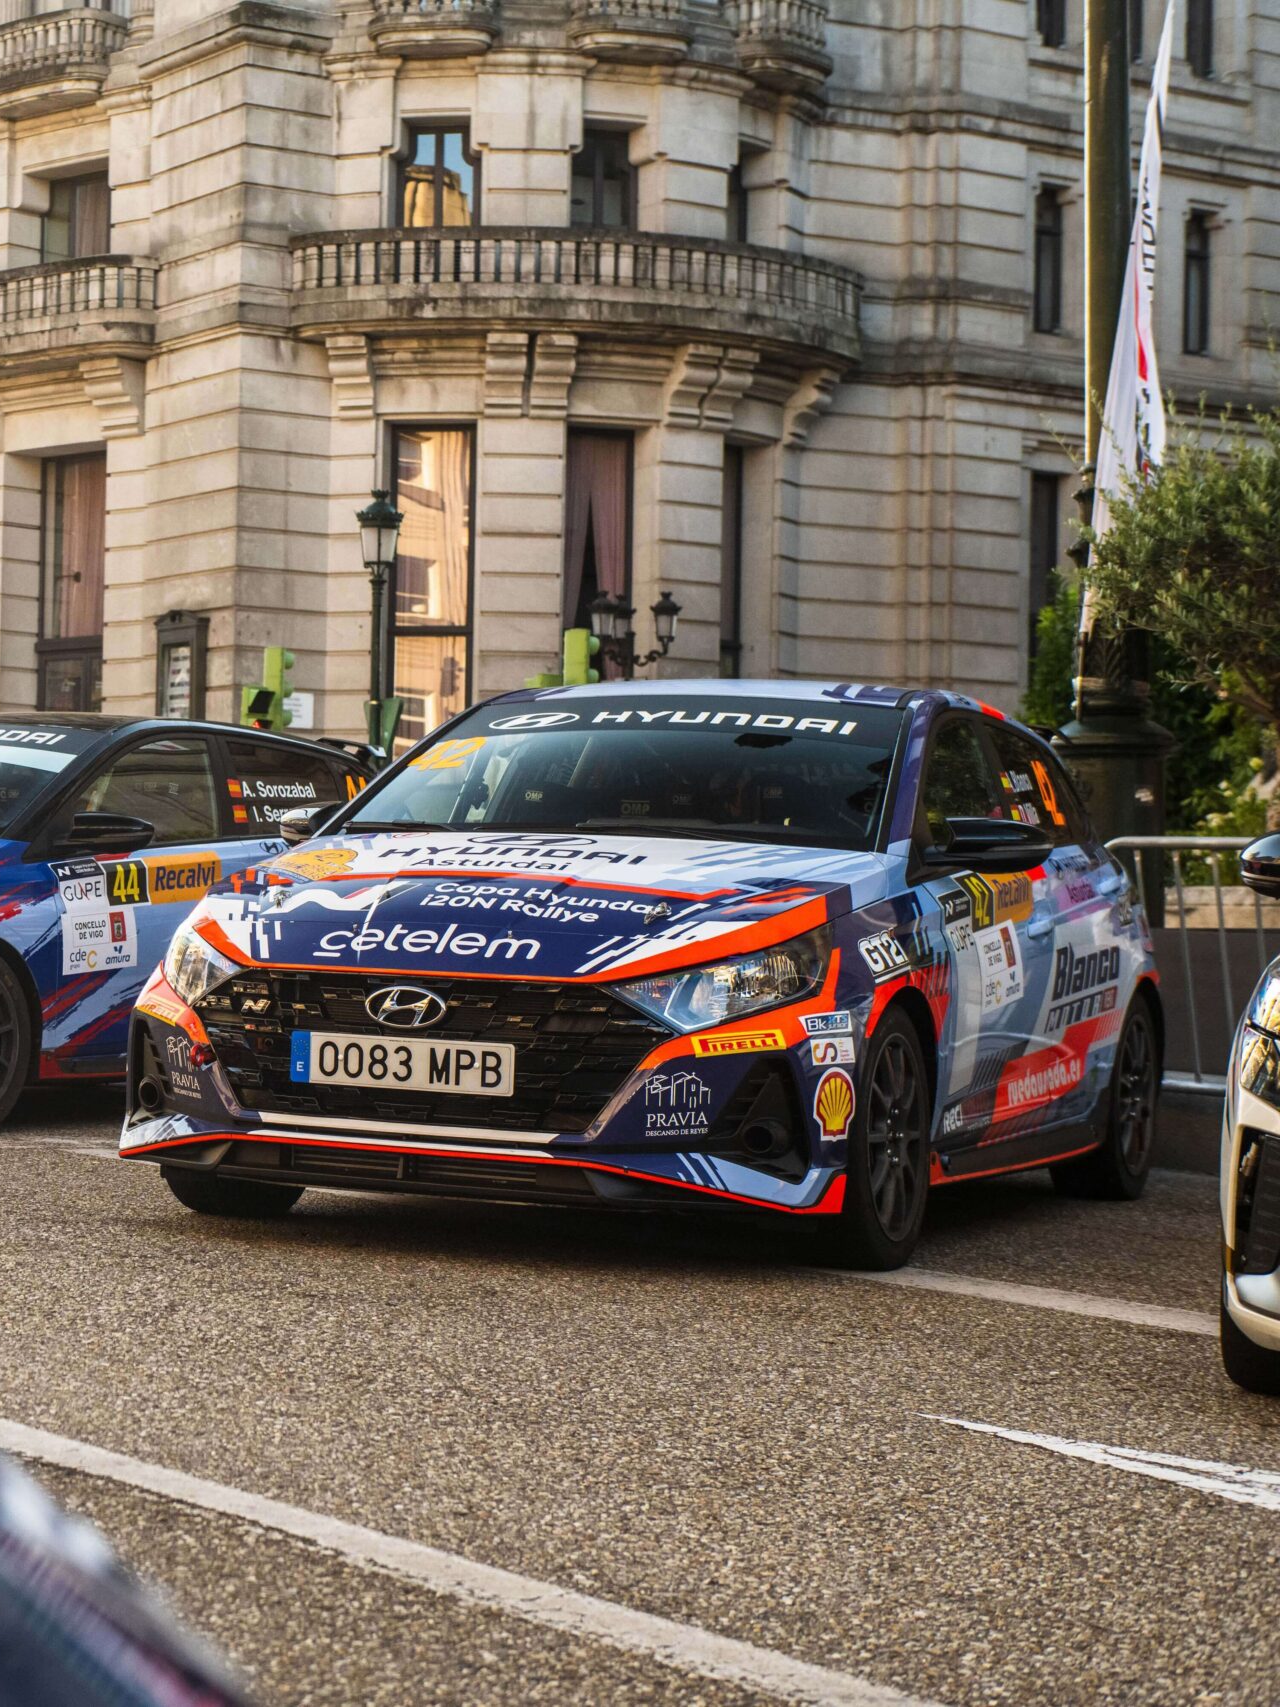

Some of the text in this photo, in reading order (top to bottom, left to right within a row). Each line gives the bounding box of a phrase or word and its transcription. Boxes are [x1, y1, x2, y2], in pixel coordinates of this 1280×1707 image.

[592, 711, 858, 735] HYUNDAI
[407, 736, 487, 771] 42
[242, 781, 316, 798] A. Sorozabal
[378, 846, 648, 865] HYUNDAI
[411, 858, 572, 871] Asturdai
[113, 863, 140, 903] 44
[155, 861, 216, 891] Recalvi
[420, 894, 600, 923] i20N Rallye
[435, 882, 668, 915] Copa Hyunda
[964, 876, 990, 928] 42
[74, 919, 107, 931] CONCELLO
[79, 930, 104, 940] DE VIGO
[313, 924, 541, 960] cetelem
[105, 954, 131, 965] amura
[1051, 942, 1120, 1001] Blanco
[698, 1032, 779, 1053] PIRELLI
[296, 1061, 304, 1072] E
[319, 1040, 502, 1088] 0083 MPB
[171, 1071, 201, 1091] PRAVIA
[646, 1111, 709, 1128] PRAVIA
[645, 1129, 679, 1137] DESCANSO
